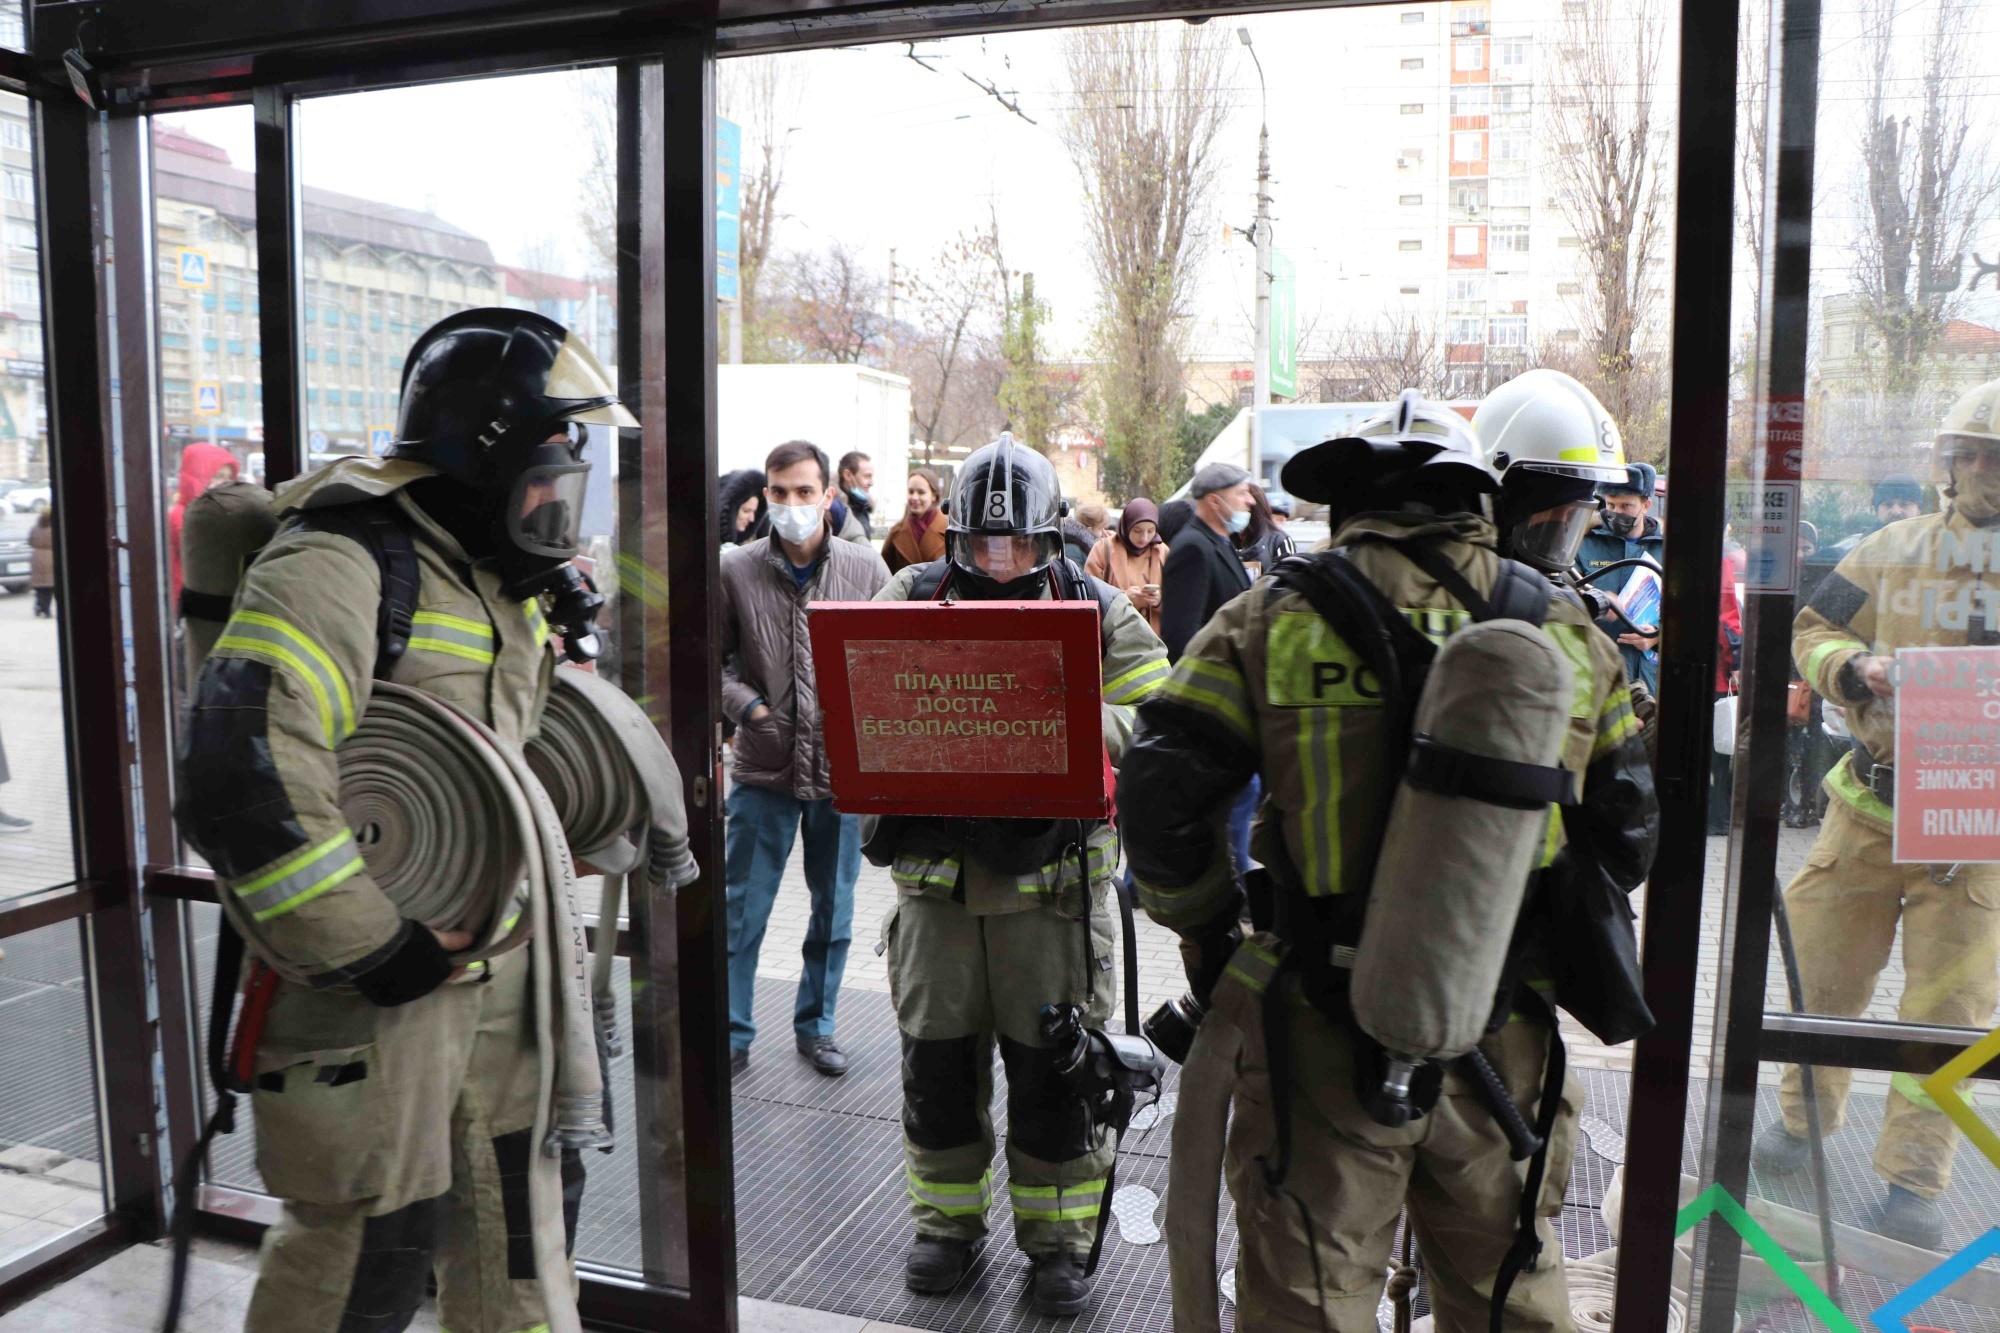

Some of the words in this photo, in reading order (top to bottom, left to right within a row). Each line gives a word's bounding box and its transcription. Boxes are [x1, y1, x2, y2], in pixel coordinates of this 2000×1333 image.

[1601, 420, 1614, 449] 8
[989, 493, 1006, 518] 8
[894, 673, 1016, 690] ПЛАНШЕТ
[916, 697, 998, 713] ПОСТА
[861, 719, 1058, 737] БЕЗОПАСНОСТИ
